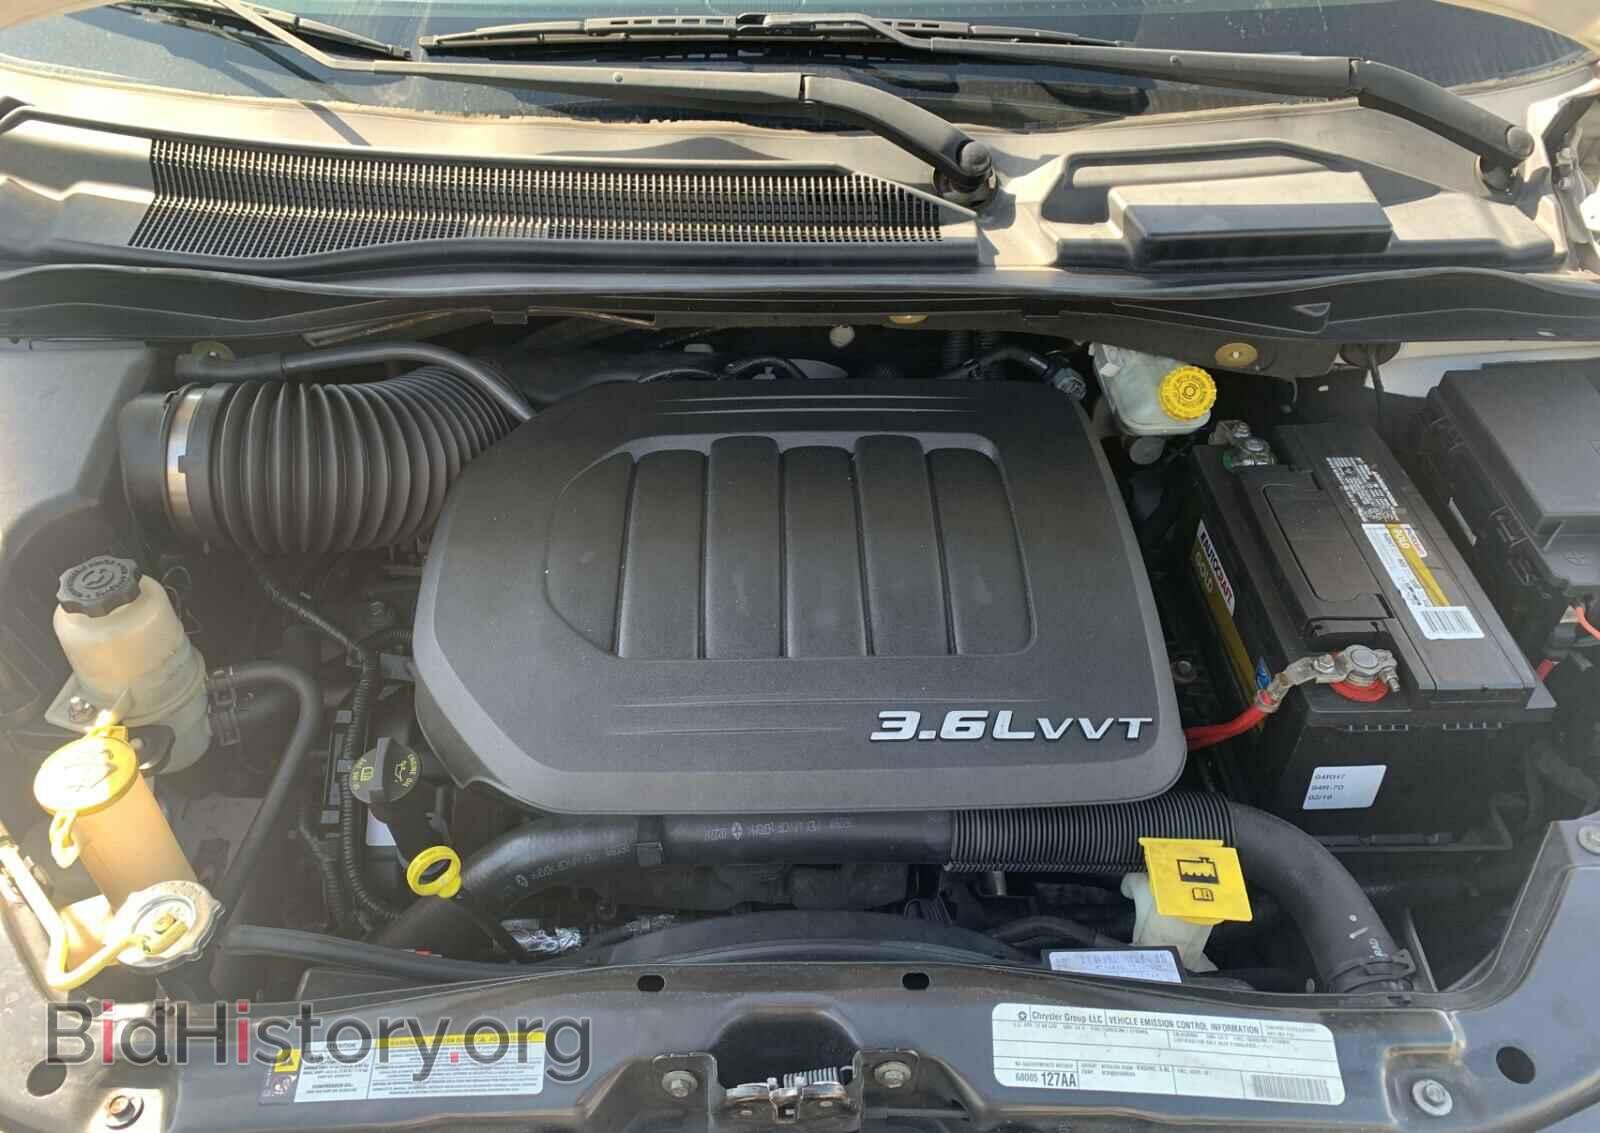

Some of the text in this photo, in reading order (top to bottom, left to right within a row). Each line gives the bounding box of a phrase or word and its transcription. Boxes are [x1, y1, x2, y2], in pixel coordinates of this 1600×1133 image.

[1031, 1010, 1103, 1024] Chrysler Group LLC
[1108, 1015, 1138, 1026] VEHICLE
[1139, 1017, 1175, 1028] EMISSION
[1176, 1020, 1208, 1031] CONTROL
[1210, 1021, 1260, 1035] INFORMATION
[1040, 1072, 1077, 1087] 127AA
